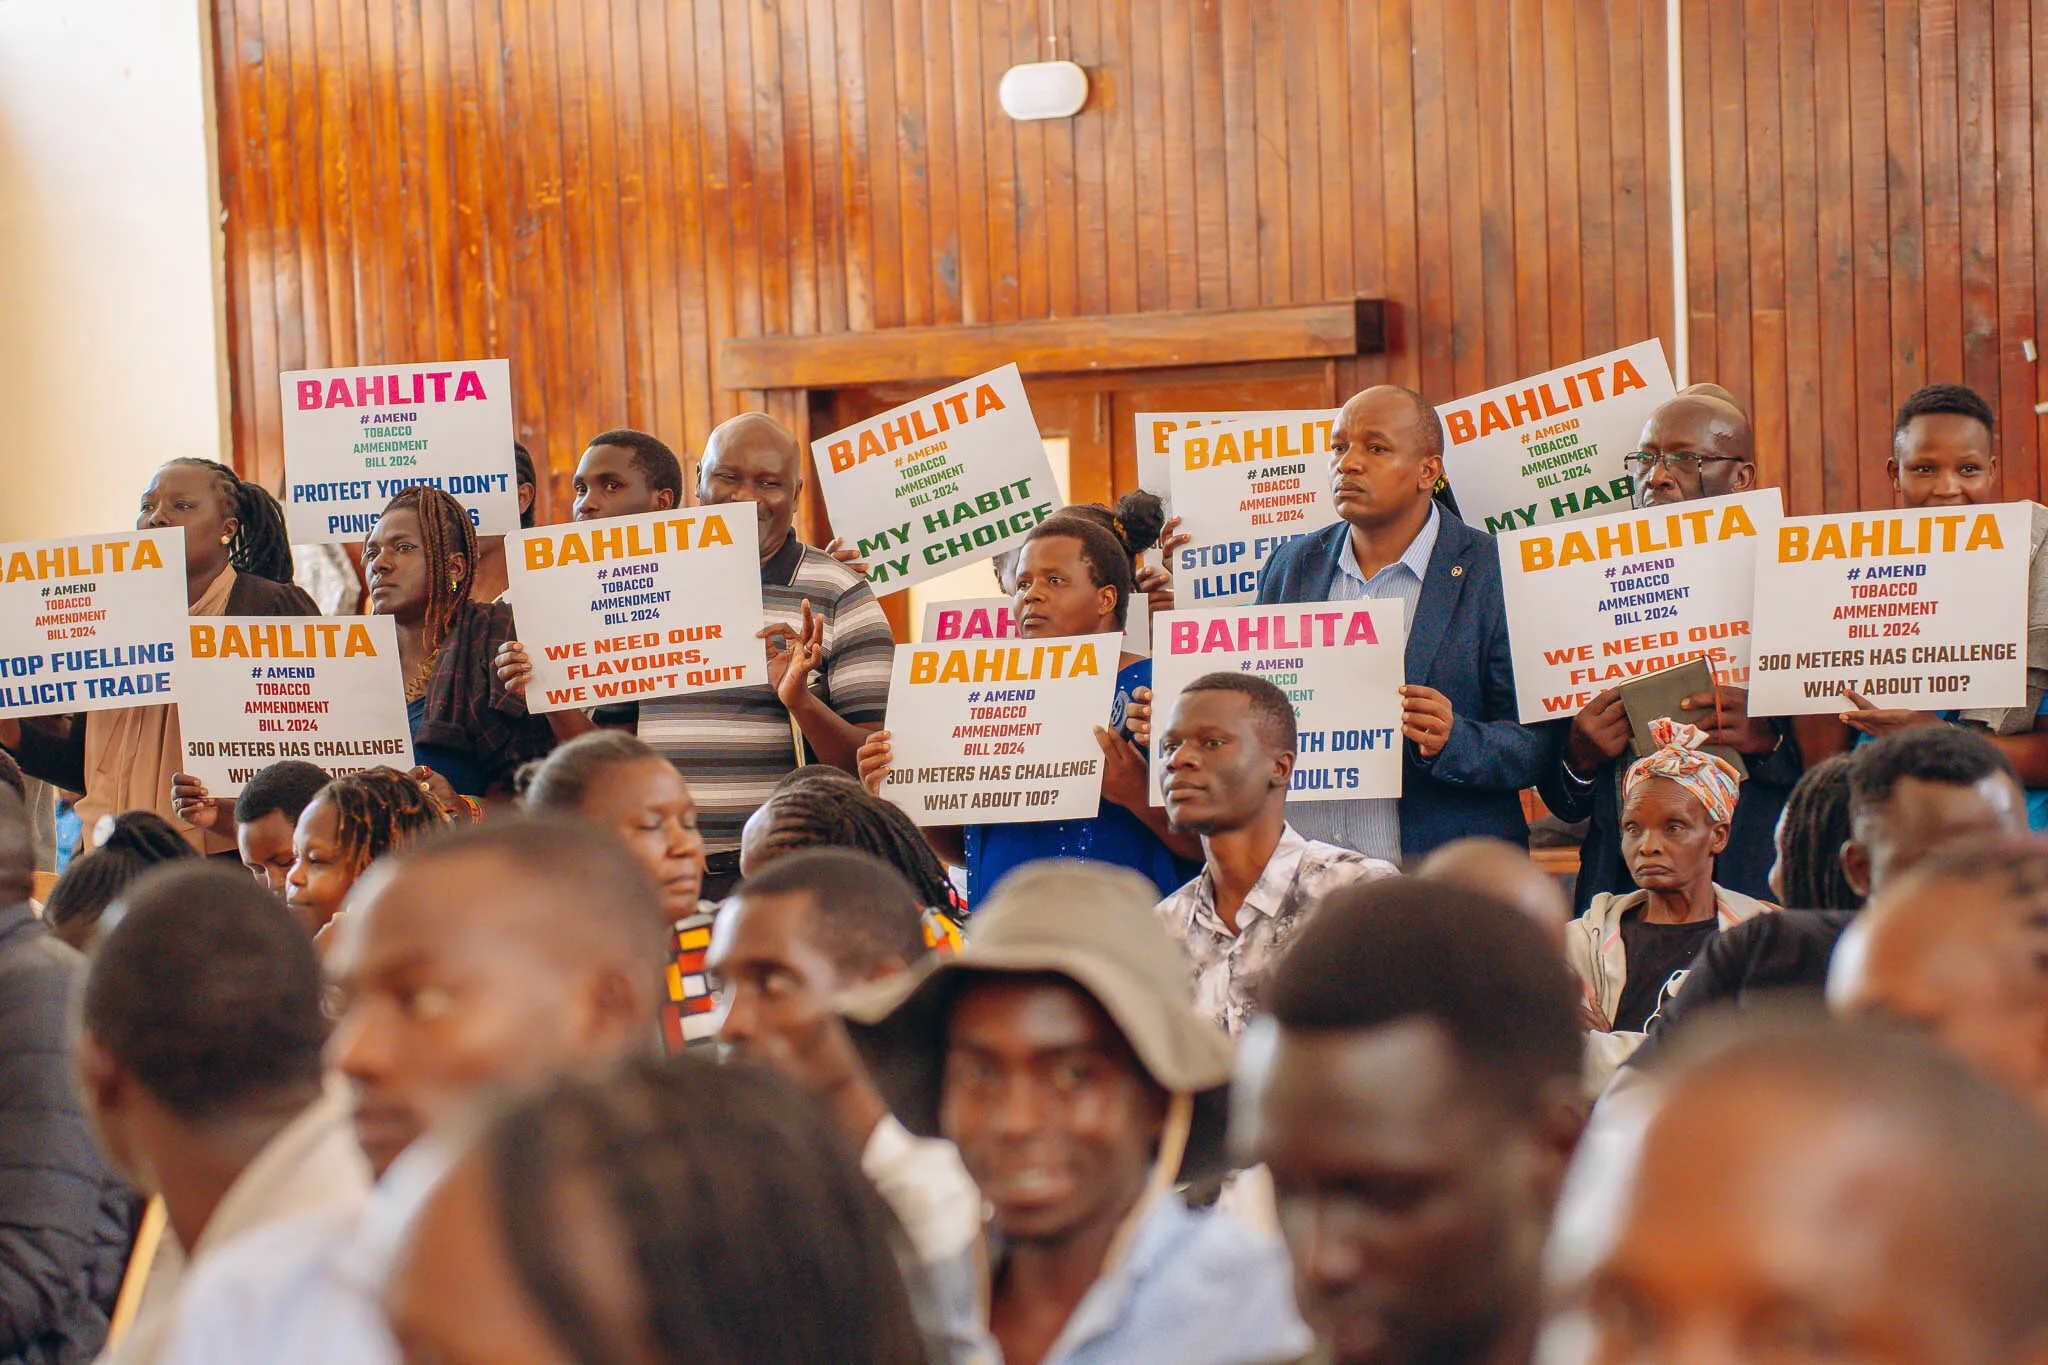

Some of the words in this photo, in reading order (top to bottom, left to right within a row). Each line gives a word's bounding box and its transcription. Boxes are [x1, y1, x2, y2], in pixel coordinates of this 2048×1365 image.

[297, 370, 487, 411] BAHLITA
[1445, 359, 1648, 445] BAHLITA
[360, 415, 369, 424] #
[374, 413, 417, 424] AMEND
[828, 384, 1006, 474] BAHLITA
[364, 426, 412, 438] TOBACCO
[1521, 434, 1530, 444] #
[1535, 418, 1580, 440] AMEND
[353, 440, 428, 454] AMMENDMENT
[894, 458, 903, 468] #
[907, 441, 947, 463] AMEND
[1184, 420, 1335, 471] BAHLIT
[1527, 434, 1578, 457] TOBACCO
[365, 457, 386, 468] BILL
[389, 456, 416, 467] 2024
[900, 455, 946, 480] TOBACCO
[1521, 444, 1599, 477] AMMENDMENT
[894, 464, 964, 498] AMMENDMENT
[1248, 469, 1257, 479] #
[1261, 464, 1305, 479] AMEND
[1537, 472, 1561, 488] BILL
[1562, 464, 1592, 484] 2024
[293, 481, 371, 503] PROTECT
[448, 474, 508, 495] DON'T
[909, 494, 932, 508] BILL
[934, 482, 959, 500] 2024
[1251, 478, 1300, 494] TOBACCO
[1239, 492, 1316, 512] AMMENDMENT
[1484, 504, 1538, 535] MY
[1550, 476, 1636, 518] HAB
[328, 513, 381, 534] PUNIS
[857, 522, 912, 558] MY
[922, 477, 1031, 534] HABIT
[1252, 512, 1273, 525] BILL
[1277, 509, 1304, 523] 2024
[524, 515, 733, 570] BAHLITA
[865, 554, 911, 584] MY
[923, 502, 1053, 566] CHOICE
[1520, 505, 1757, 572] BAHLITA
[1778, 513, 2004, 563] BAHLITA
[1182, 542, 1245, 570] STOP
[597, 569, 608, 579] #
[612, 563, 658, 578] AMEND
[1605, 568, 1616, 578] #
[1621, 558, 1675, 576] AMEND
[1847, 568, 1860, 580] #
[1866, 564, 1926, 579] AMEND
[41, 588, 50, 597] #
[54, 583, 96, 596] AMEND
[602, 577, 654, 594] TOBACCO
[1194, 571, 1262, 599] ILLIC
[1610, 574, 1670, 592] TOBACCO
[1851, 582, 1917, 599] TOBACCO
[45, 597, 91, 610] TOBACCO
[590, 591, 671, 612] AMMENDMENT
[1599, 587, 1690, 612] AMMENDMENT
[36, 610, 106, 626] AMMENDMENT
[605, 612, 628, 625] BILL
[631, 608, 659, 622] 2024
[1615, 611, 1642, 626] BILL
[1645, 605, 1678, 621] 2024
[1833, 601, 1939, 620] AMMENDMENT
[47, 629, 68, 640] BILL
[71, 626, 96, 638] 2024
[1171, 611, 1378, 655] BAHLITA
[1849, 625, 1879, 638] BILL
[1883, 622, 1920, 636] 2024
[190, 624, 377, 658] BAHLITA
[545, 642, 587, 660] WE
[594, 632, 659, 654] NEED
[668, 624, 722, 644] OUR
[1543, 645, 1594, 666] WE
[1603, 631, 1678, 657] NEED
[1689, 620, 1750, 642] OUR
[0, 655, 43, 678] TOP
[52, 642, 174, 672] FUELLING
[567, 649, 710, 680] FLAVOURS,
[909, 643, 1099, 684] BAHLITA
[1241, 661, 1251, 671] #
[1256, 658, 1304, 670] AMEND
[1759, 654, 1791, 671] 300
[1796, 650, 1864, 669] METERS
[1870, 648, 1907, 665] HAS
[1912, 643, 2017, 664] CHALLENGE
[251, 668, 262, 678] #
[267, 667, 315, 678] AMEND
[1259, 673, 1298, 685] ACCO
[0, 681, 77, 707] ILLICIT
[84, 672, 171, 699] TRADE
[256, 683, 310, 695] TOBACCO
[546, 686, 587, 705] WE
[593, 674, 678, 698] WON'T
[686, 665, 746, 686] QUIT
[968, 692, 980, 702] #
[984, 689, 1035, 702] AMEND
[1804, 679, 1858, 698] WHAT
[1863, 677, 1923, 695] ABOUT
[1928, 675, 1970, 693] 100?
[245, 701, 329, 713] AMMENDMENT
[971, 706, 1026, 720] TOBACCO
[1542, 692, 1591, 713] WE
[259, 720, 283, 731] BILL
[287, 719, 318, 731] 2024
[952, 723, 1042, 738] AMMENDMENT
[188, 742, 214, 756] 300
[219, 742, 275, 756] METERS
[280, 742, 310, 756] HAS
[314, 739, 404, 756] CHALLENGE
[964, 743, 989, 756] BILL
[994, 742, 1025, 755] 2024
[1332, 728, 1394, 751] DON'T
[228, 768, 261, 783] WH
[887, 768, 913, 785] 300
[918, 766, 975, 783] METERS
[979, 765, 1010, 781] HAS
[1015, 760, 1097, 779] CHALLENGE
[924, 793, 968, 811] WHAT
[971, 792, 1021, 809] ABOUT
[1025, 790, 1059, 806] 100?
